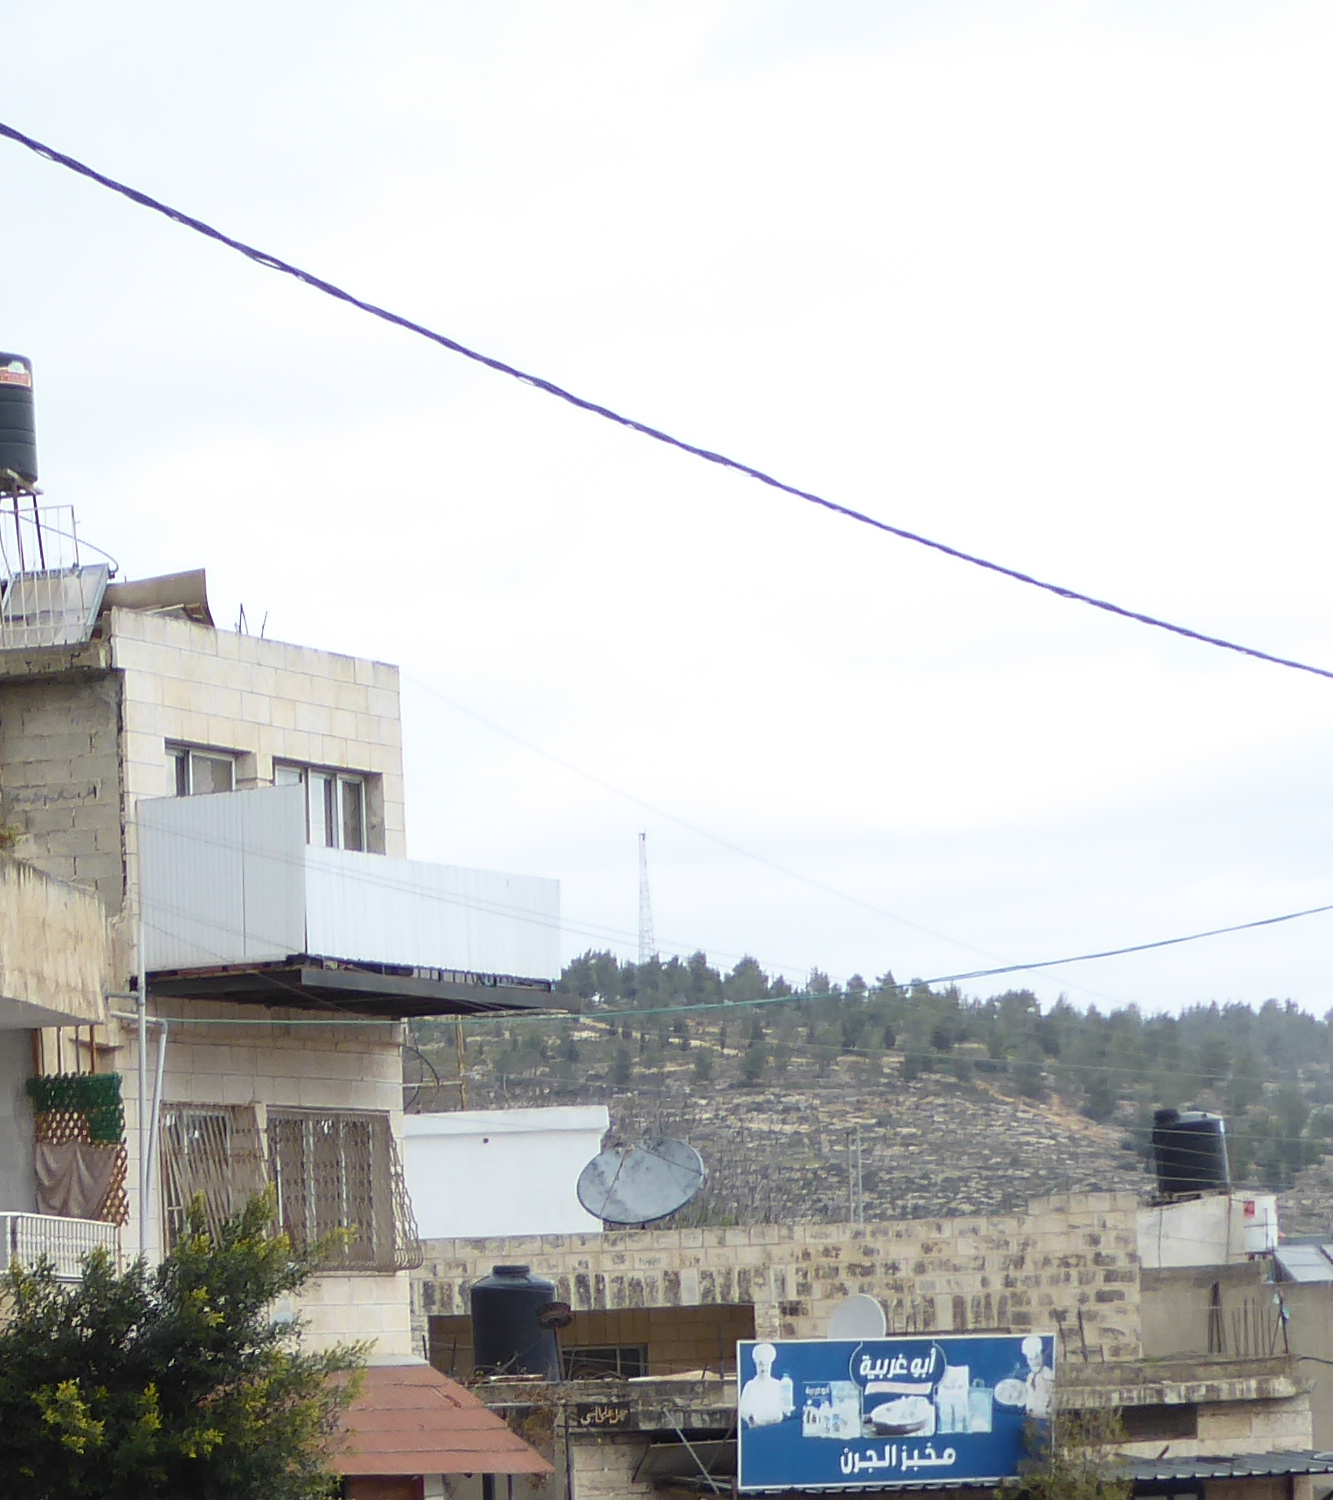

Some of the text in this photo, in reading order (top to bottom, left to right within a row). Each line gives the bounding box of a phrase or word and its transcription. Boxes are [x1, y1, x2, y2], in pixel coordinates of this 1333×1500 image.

[859, 1353, 909, 1379] غربية
[840, 1442, 956, 1474] مخبز الجرن
